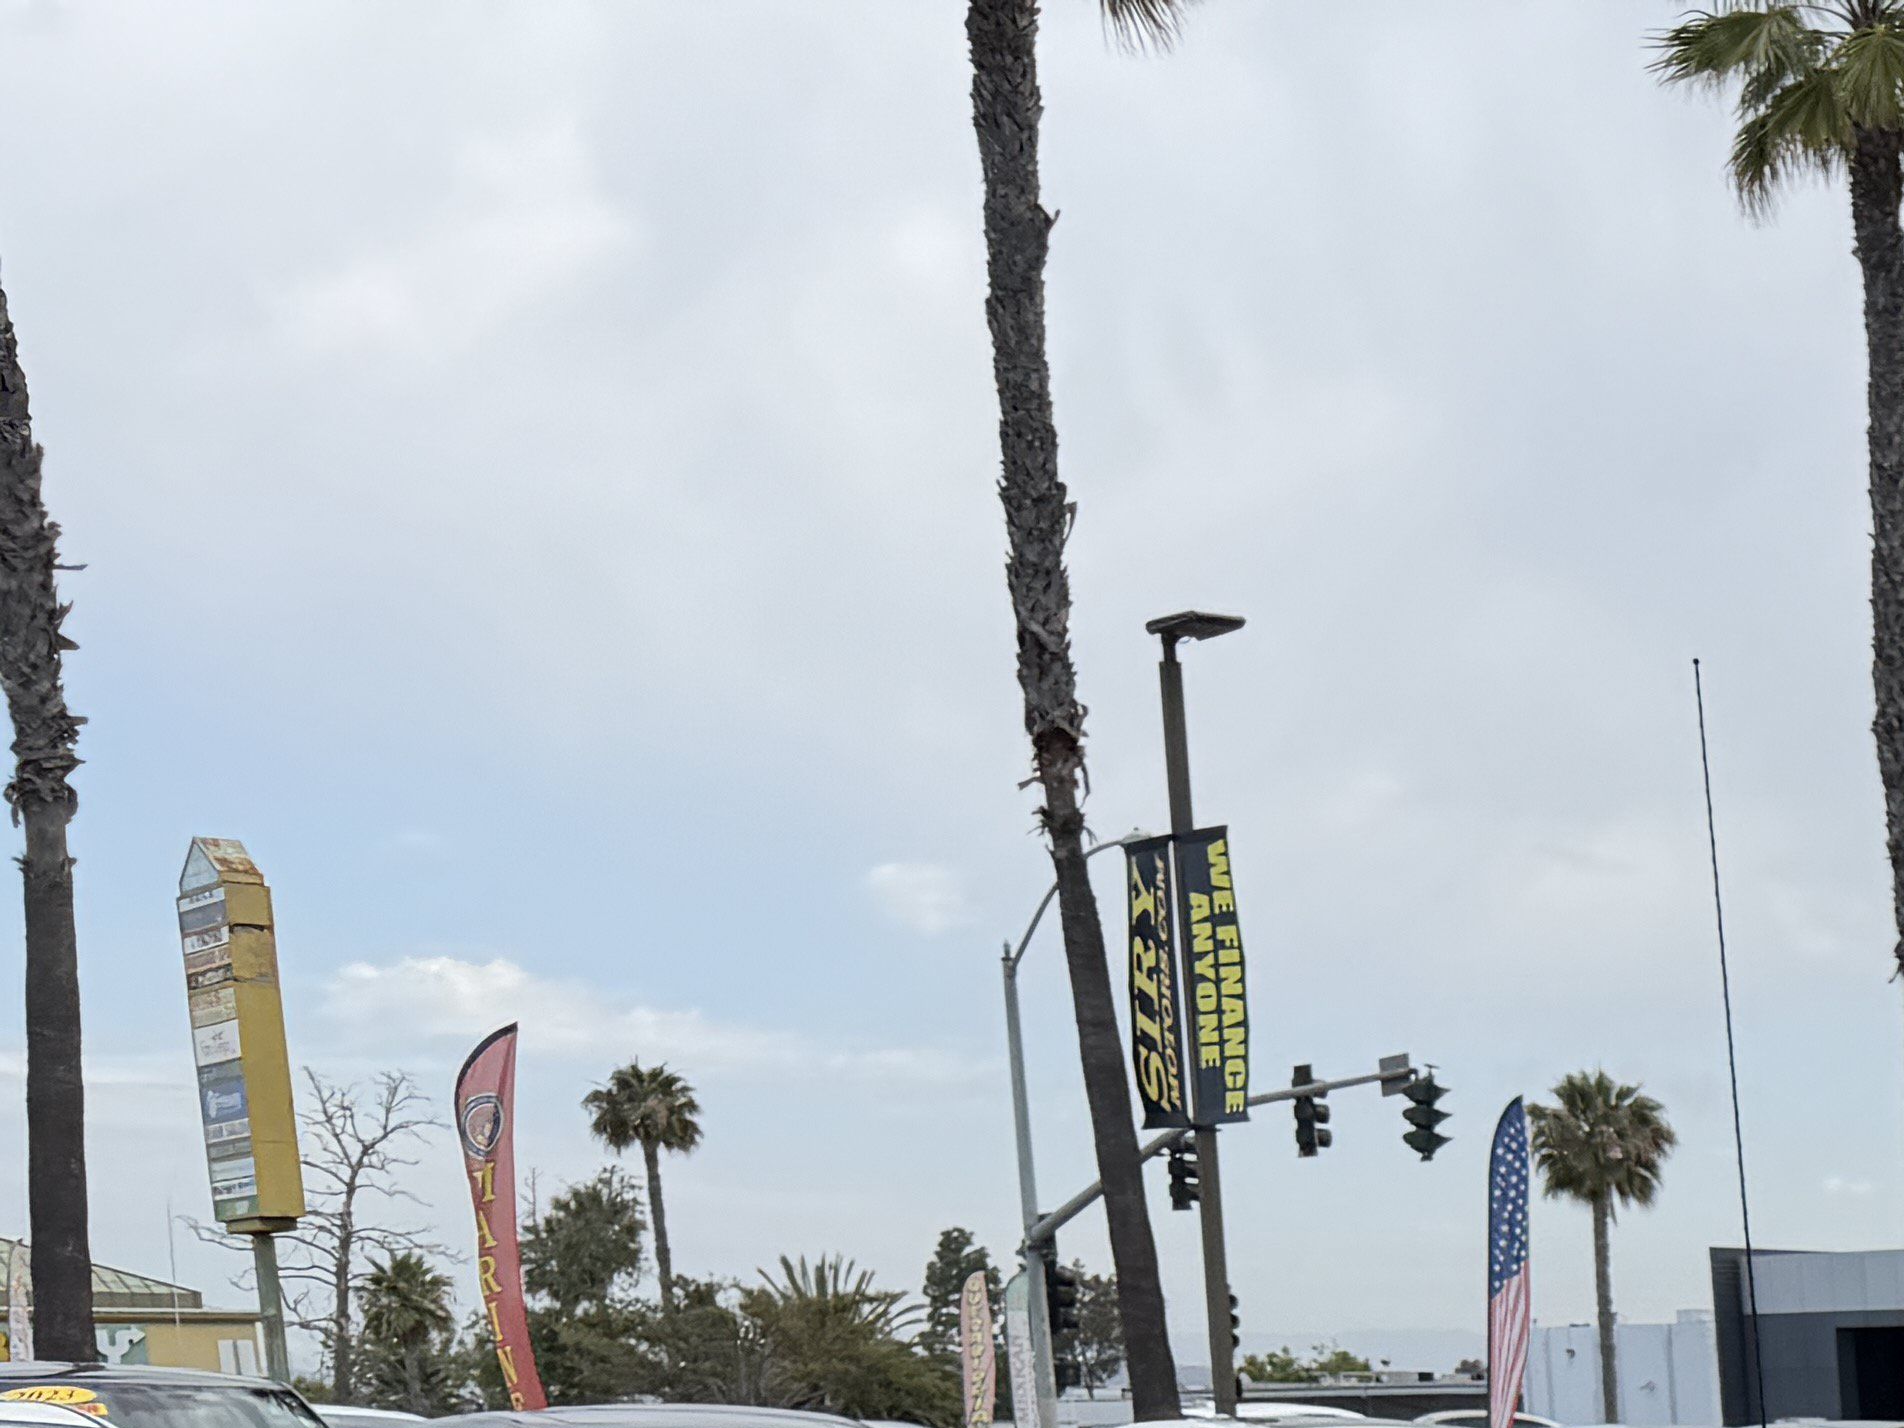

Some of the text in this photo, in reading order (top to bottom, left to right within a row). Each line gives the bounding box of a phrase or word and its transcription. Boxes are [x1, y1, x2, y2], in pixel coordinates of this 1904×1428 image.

[1131, 855, 1171, 1113] SIRY
[1189, 892, 1221, 1069] ANYONE
[1207, 840, 1245, 1114] WE FINANCE
